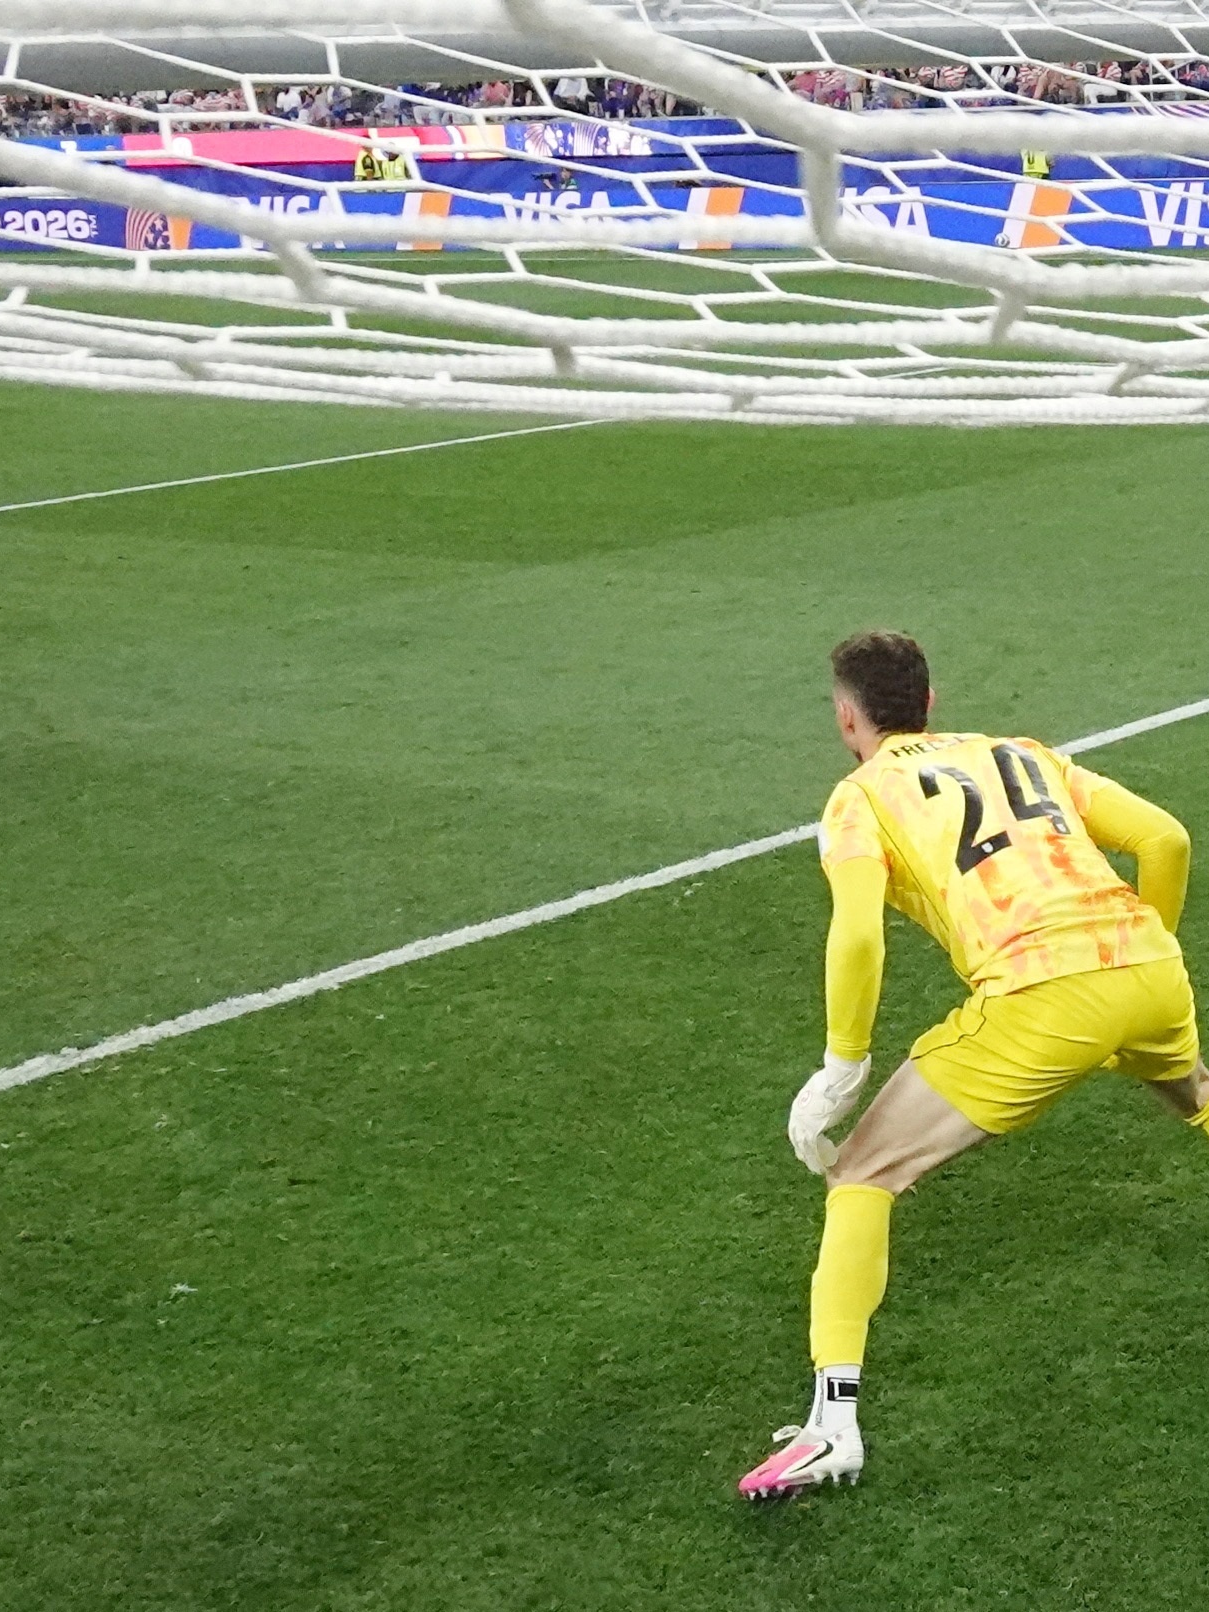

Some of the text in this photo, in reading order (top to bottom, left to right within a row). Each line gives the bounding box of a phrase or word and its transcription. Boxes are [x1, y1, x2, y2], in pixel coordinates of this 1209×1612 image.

[3, 210, 91, 239] 2026
[805, 185, 931, 239] ISA
[1140, 181, 1209, 247] VI
[918, 742, 1071, 876] 24
